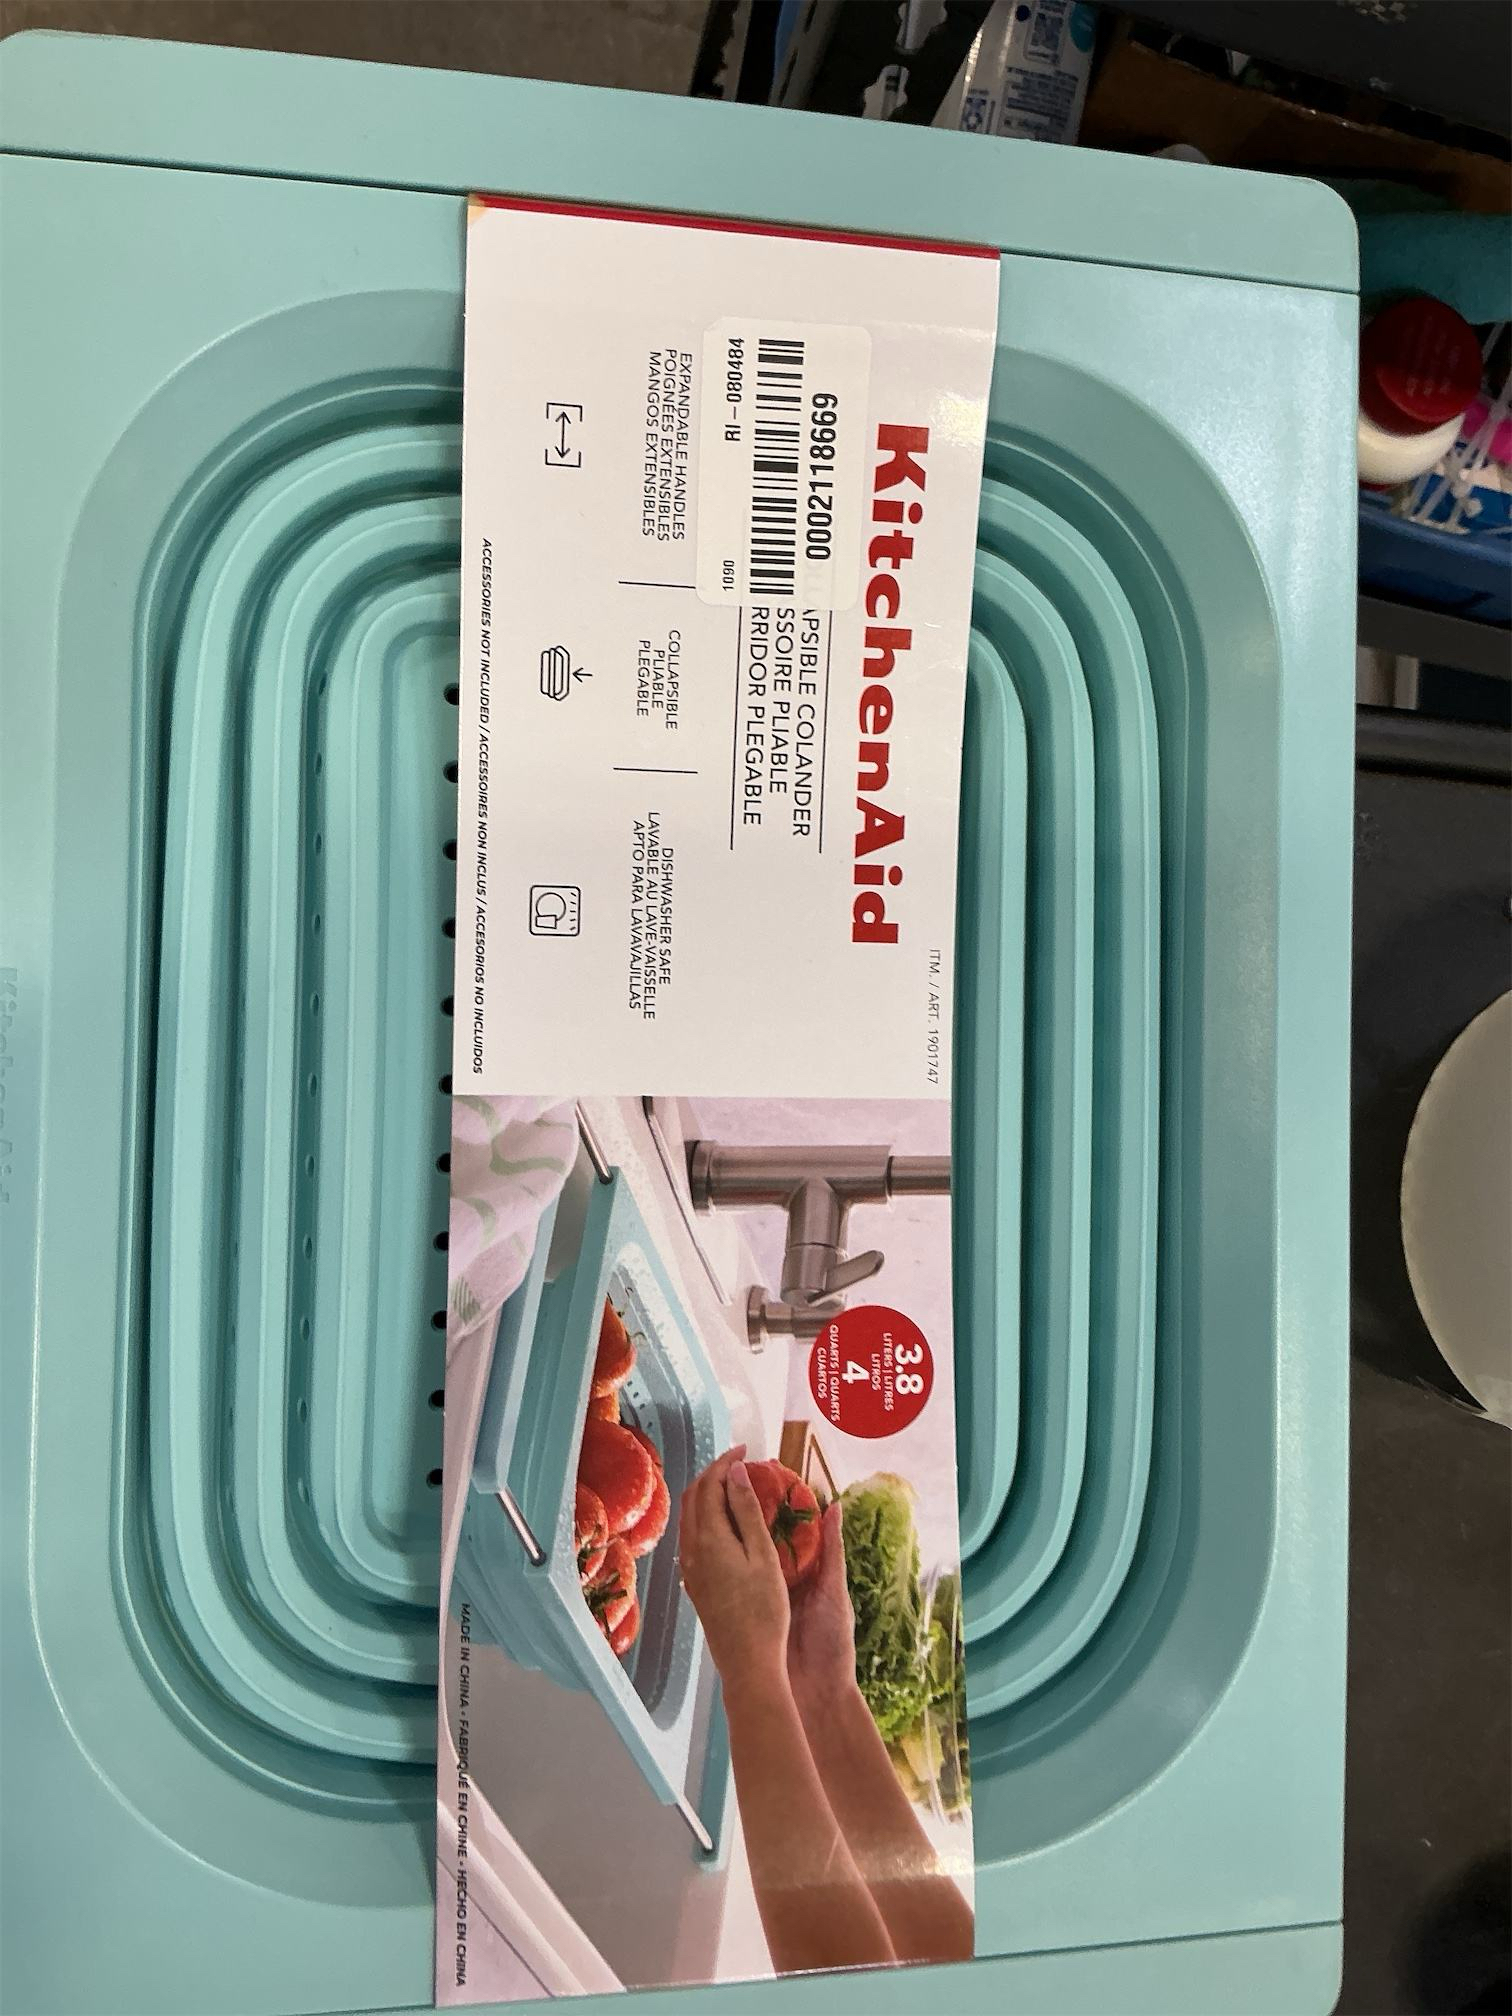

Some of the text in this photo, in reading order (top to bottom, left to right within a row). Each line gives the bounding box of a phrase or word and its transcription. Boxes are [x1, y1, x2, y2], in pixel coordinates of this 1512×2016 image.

[642, 351, 662, 536] MANGOS EXTENSIBLES
[657, 349, 679, 541] POIGNÉES EXTENSIBLES
[672, 353, 692, 540] EXPANDABLE HANDLES
[806, 393, 838, 560] 0002118669
[480, 538, 493, 627] ACCESSORIES
[722, 560, 735, 592] 1090
[480, 629, 492, 656] NOT
[478, 658, 491, 724] INCLUDED
[636, 640, 650, 716] PLEGABLE
[652, 649, 665, 709] PLIABLE
[665, 630, 680, 730] COLLAPSIBLE
[852, 424, 930, 944] KitchenAid
[743, 706, 765, 825] PLEGABLE
[770, 701, 790, 794] PLIABLE
[792, 704, 815, 837] COLANDER
[478, 734, 489, 818] ACCESSOIRES
[477, 821, 488, 850] NON
[476, 851, 487, 896] INCLUS
[628, 820, 645, 1010] APTO PARA LAVAVAJILLAS
[643, 812, 660, 1020] LAVABLE AU LAVE-VAISSELLE
[658, 848, 674, 985] DISHWASHER SAFE
[474, 905, 486, 984] ACCESORIOS
[928, 950, 940, 977] ITM.
[474, 986, 484, 1006] NO
[928, 992, 940, 1023] ART.
[472, 1008, 484, 1074] INCLUIDOS
[927, 1030, 939, 1084] 1901747
[829, 1324, 840, 1369] QUARTS
[840, 1360, 870, 1384] 4
[871, 1353, 882, 1391] LITROS
[882, 1332, 893, 1368] LITERS
[894, 1343, 924, 1395] 3.8
[816, 1347, 828, 1399] CUARTOS
[830, 1376, 840, 1422] QUARTS
[884, 1375, 894, 1412] LITRES
[460, 1603, 470, 1644] MADE
[460, 1648, 470, 1662] IN
[459, 1664, 470, 1708] CHINA
[457, 1719, 470, 1789] FABRIQUÉ
[458, 1792, 468, 1812] EN
[457, 1815, 468, 1858] CHINE
[456, 1868, 467, 1920] HECHO
[456, 1922, 466, 1942] EN
[456, 1944, 466, 1987] CHINA
